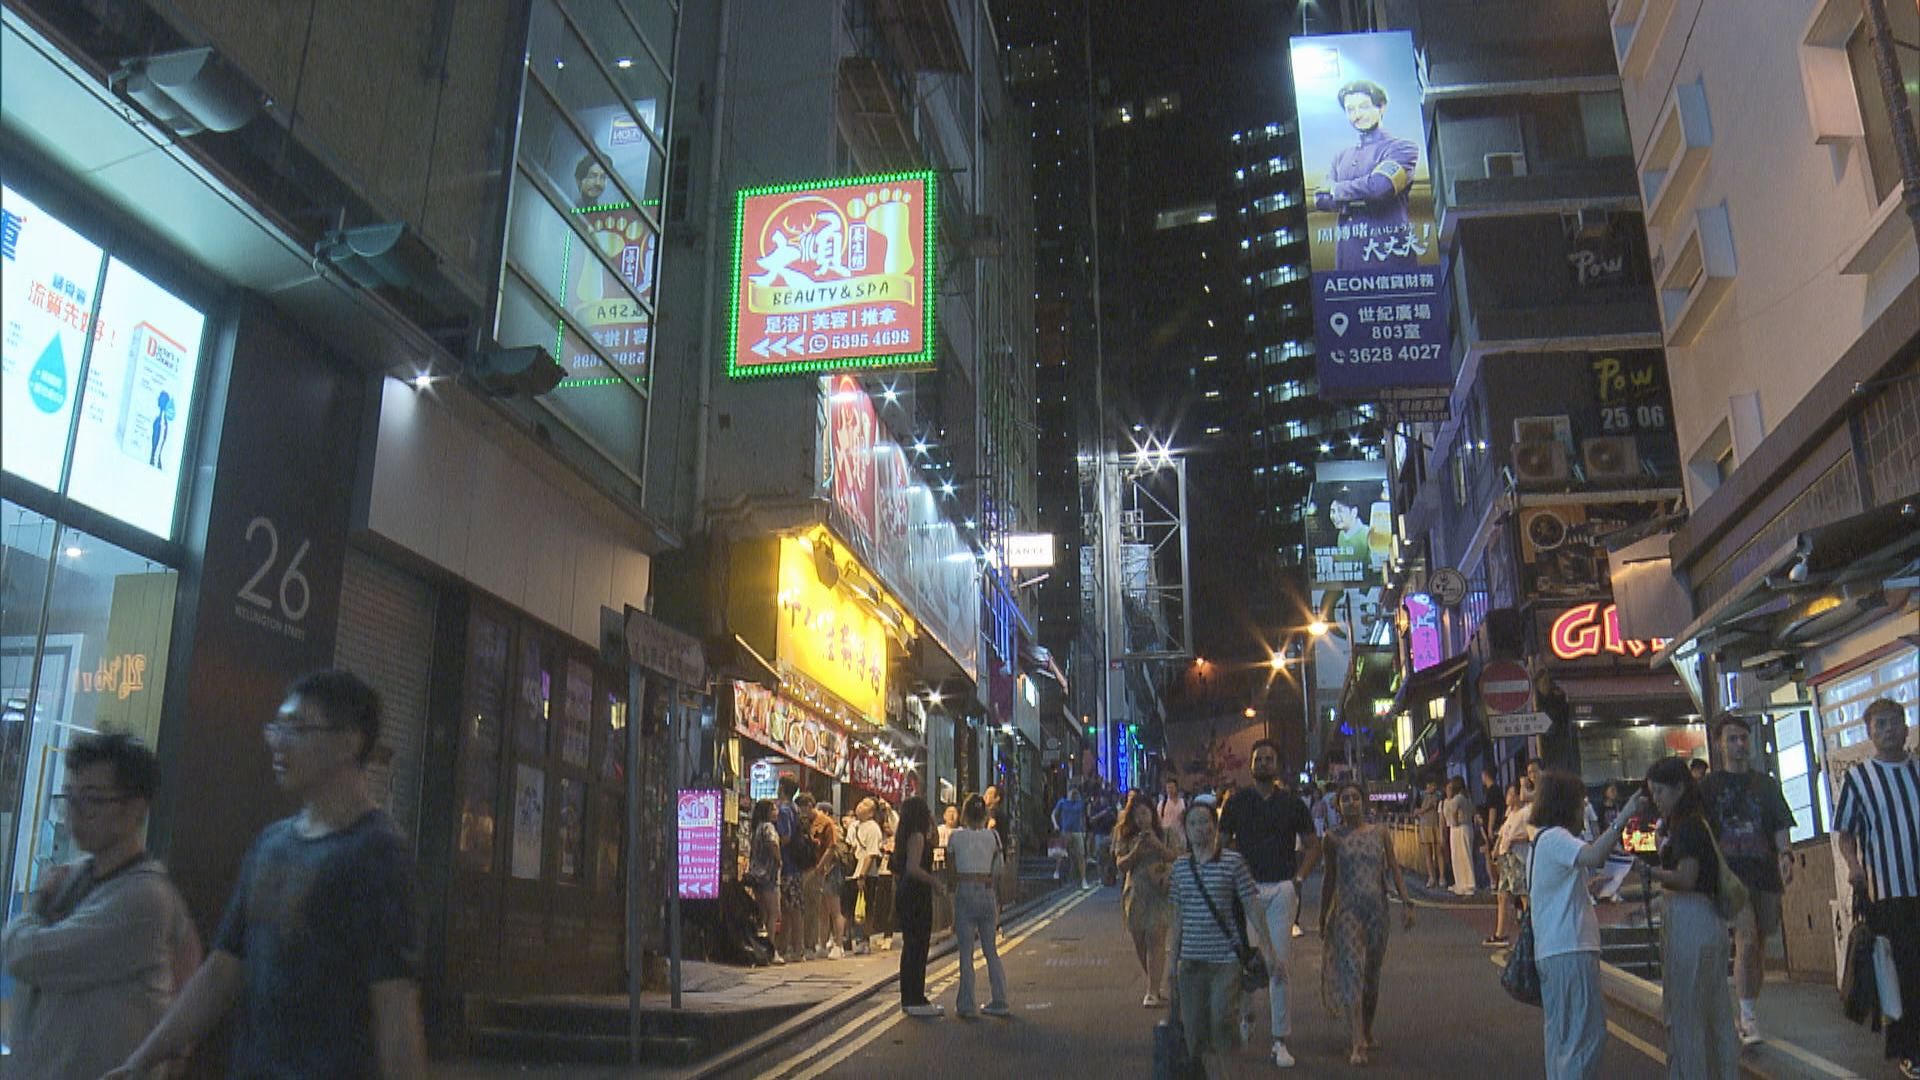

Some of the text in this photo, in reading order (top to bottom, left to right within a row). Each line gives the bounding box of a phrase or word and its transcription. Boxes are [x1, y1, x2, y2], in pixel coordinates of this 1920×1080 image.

[1568, 250, 1623, 284] Pow
[812, 311, 848, 330] 美容
[860, 305, 896, 326] 推拿
[1358, 304, 1431, 323] 世紀廣場
[872, 330, 910, 346] 4698
[1372, 324, 1420, 339] 803室
[1350, 344, 1441, 364] 3628 4027
[1592, 358, 1654, 400] Pow
[1601, 405, 1664, 429] 25 06
[238, 517, 311, 621] 26
